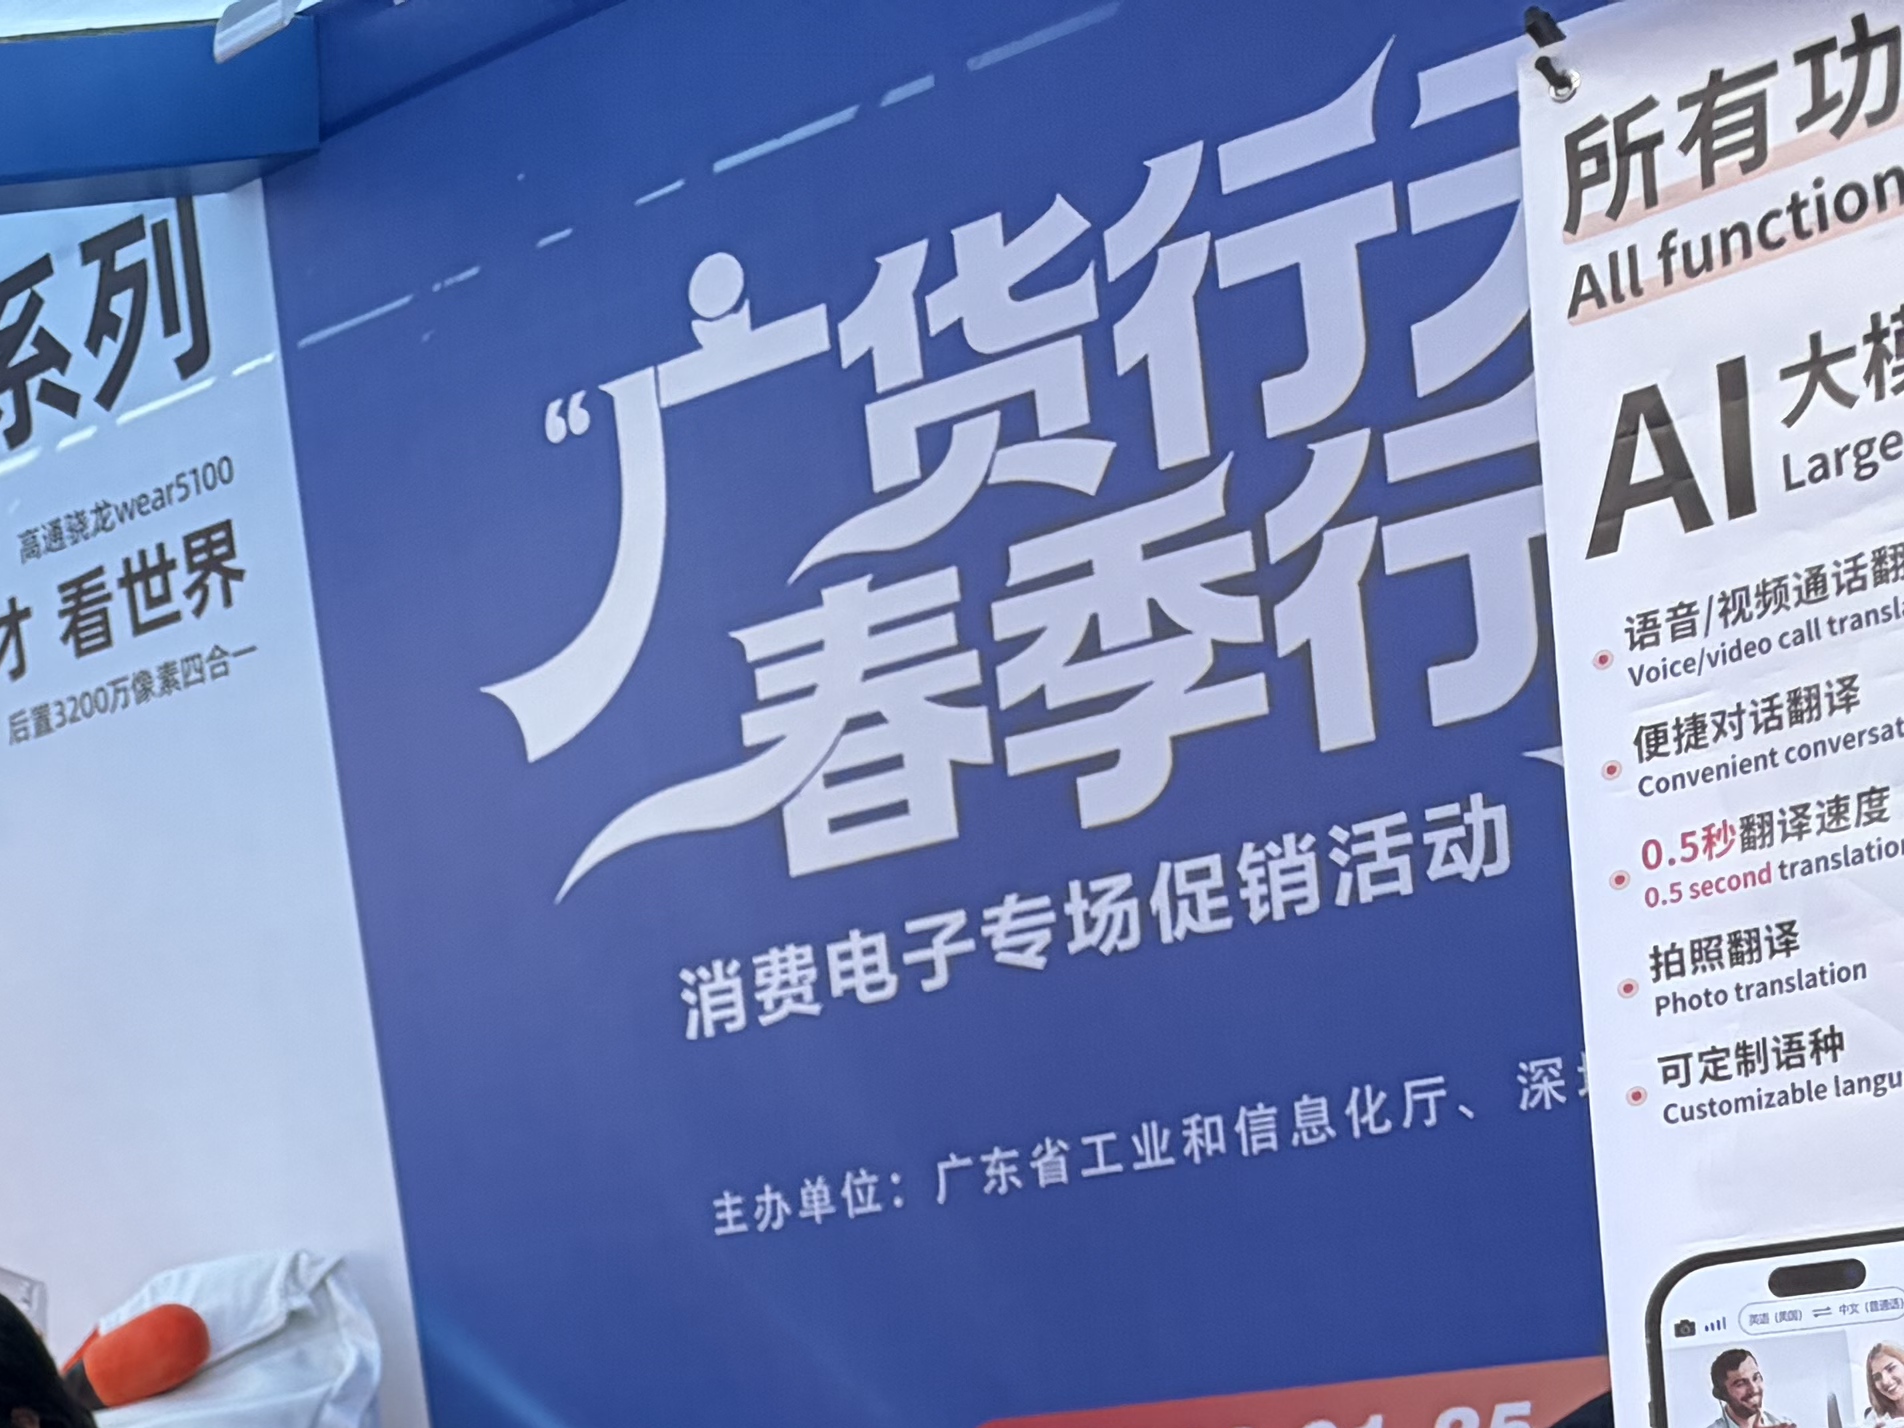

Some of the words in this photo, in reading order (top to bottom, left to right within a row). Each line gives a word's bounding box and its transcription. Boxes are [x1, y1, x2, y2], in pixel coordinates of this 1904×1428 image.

[1563, 12, 1903, 235] 所有功
[1567, 244, 1644, 320] All
[1585, 355, 1758, 560] AI
[1783, 430, 1904, 491] Large
[56, 518, 246, 660] 看世界
[1628, 633, 1772, 687] Voice/video
[1778, 616, 1822, 650] call
[7, 643, 259, 746] 后置3200万像素四合一
[1633, 674, 1861, 764] 便捷对话翻译
[1638, 748, 1780, 798] Convenient
[1641, 785, 1891, 871] 0.5秒翻译速度
[1644, 881, 1683, 909] 0.5
[1689, 861, 1772, 900] second
[1778, 836, 1904, 880] translatio
[677, 793, 1511, 1042] 消费电子专场促销活动
[1649, 919, 1801, 984] 拍照翻译
[1655, 984, 1728, 1017] Photo
[1734, 960, 1868, 1004] translation
[1657, 1024, 1845, 1090] 可定制语种
[1662, 1073, 1829, 1126] Customizable
[712, 1050, 1590, 1239] 主办单位：广东省工业和信息化厅、深
